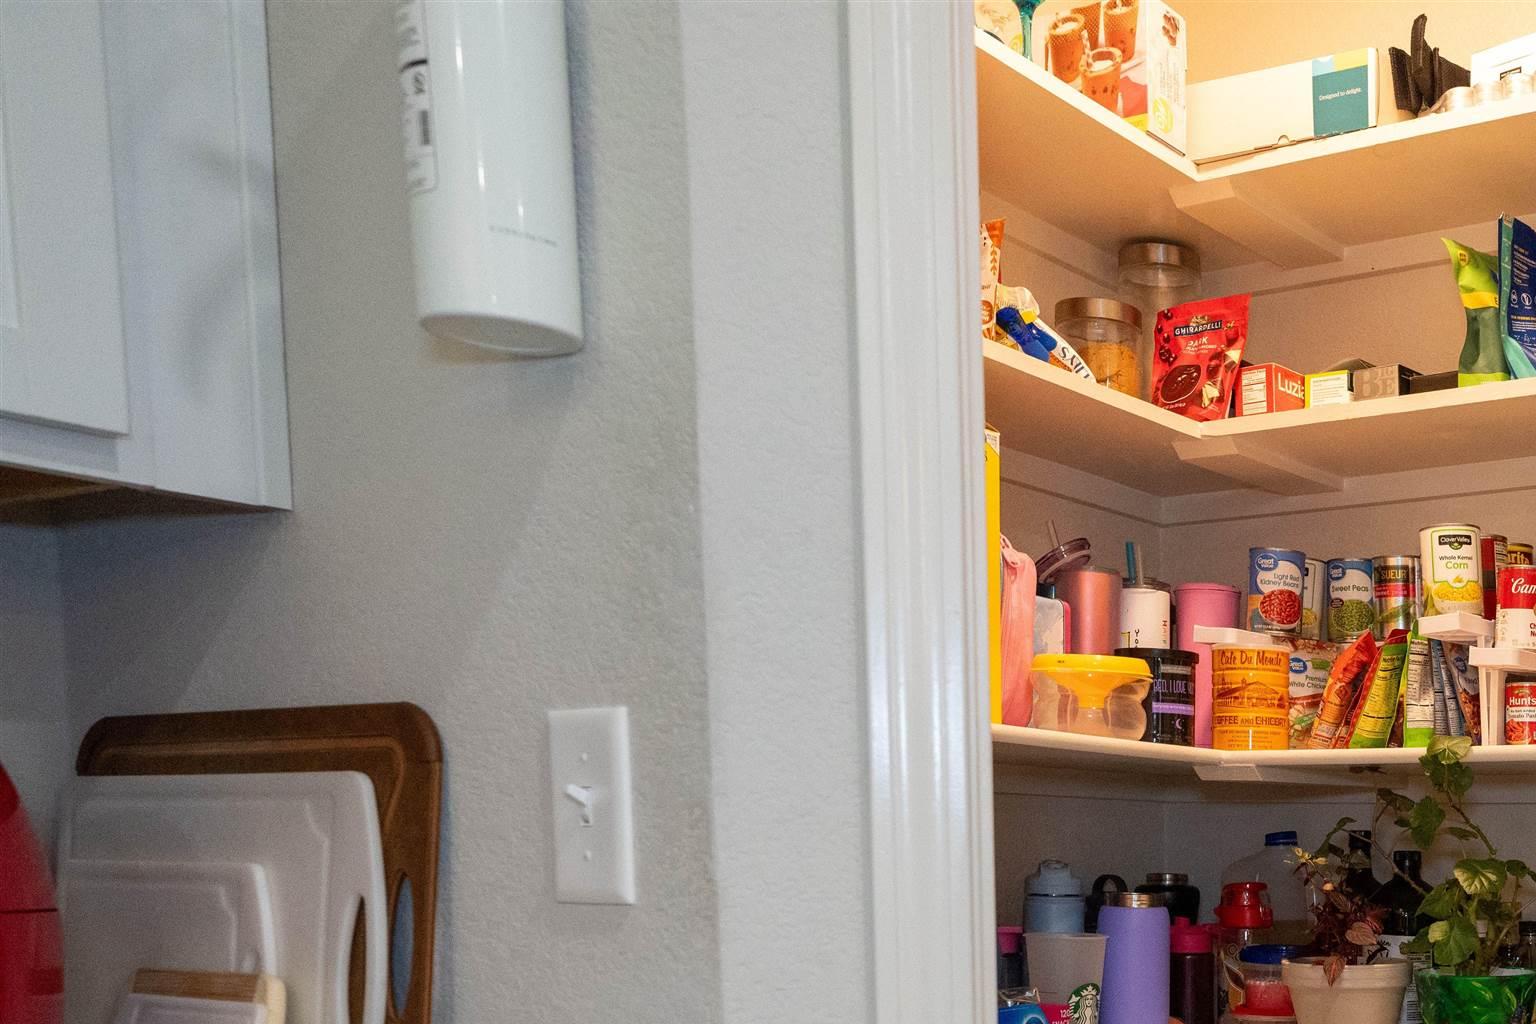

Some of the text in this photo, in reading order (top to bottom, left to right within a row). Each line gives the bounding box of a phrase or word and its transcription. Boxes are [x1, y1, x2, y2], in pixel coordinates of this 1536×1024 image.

[1174, 321, 1222, 335] GHIRARDELLI
[1439, 554, 1456, 562] Whole
[1445, 561, 1469, 570] Corn
[1273, 573, 1300, 582] Light Red
[1260, 579, 1300, 588] Kidney Beans
[1331, 584, 1369, 593] Sweet Peas
[1239, 651, 1254, 665] Du
[1255, 651, 1284, 667] Monde
